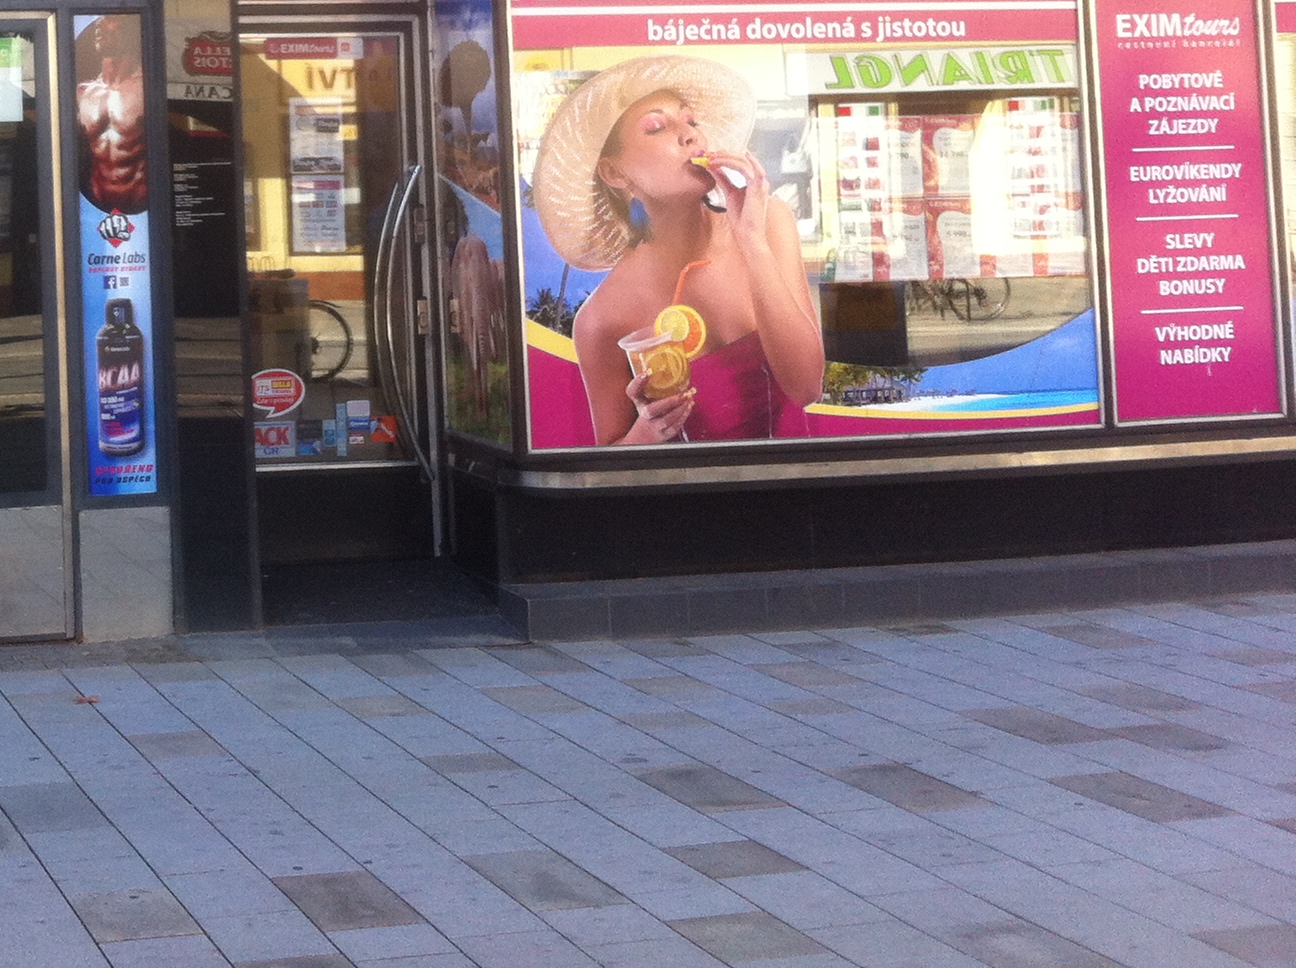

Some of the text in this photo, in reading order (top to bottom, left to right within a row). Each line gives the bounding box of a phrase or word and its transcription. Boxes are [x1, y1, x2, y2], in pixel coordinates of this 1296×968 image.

[647, 16, 966, 45] báječná dovolená s jistotou
[1139, 70, 1224, 91] POBYTOVÉ
[1130, 92, 1235, 113] A POZNÁVACÍ
[1148, 115, 1219, 136] ZÁJEZDY
[1129, 161, 1242, 183] EUROVÍKENDY
[1148, 181, 1227, 205] LYŽOVÁNÍ
[1165, 231, 1215, 250] SLEVY
[88, 251, 146, 265] Carne Labs
[1137, 253, 1245, 275] DĚTI ZDARMA
[1159, 278, 1226, 296] BONUSY
[1155, 319, 1235, 343] VÝHODNÉ
[1160, 345, 1232, 366] NABÍDKY
